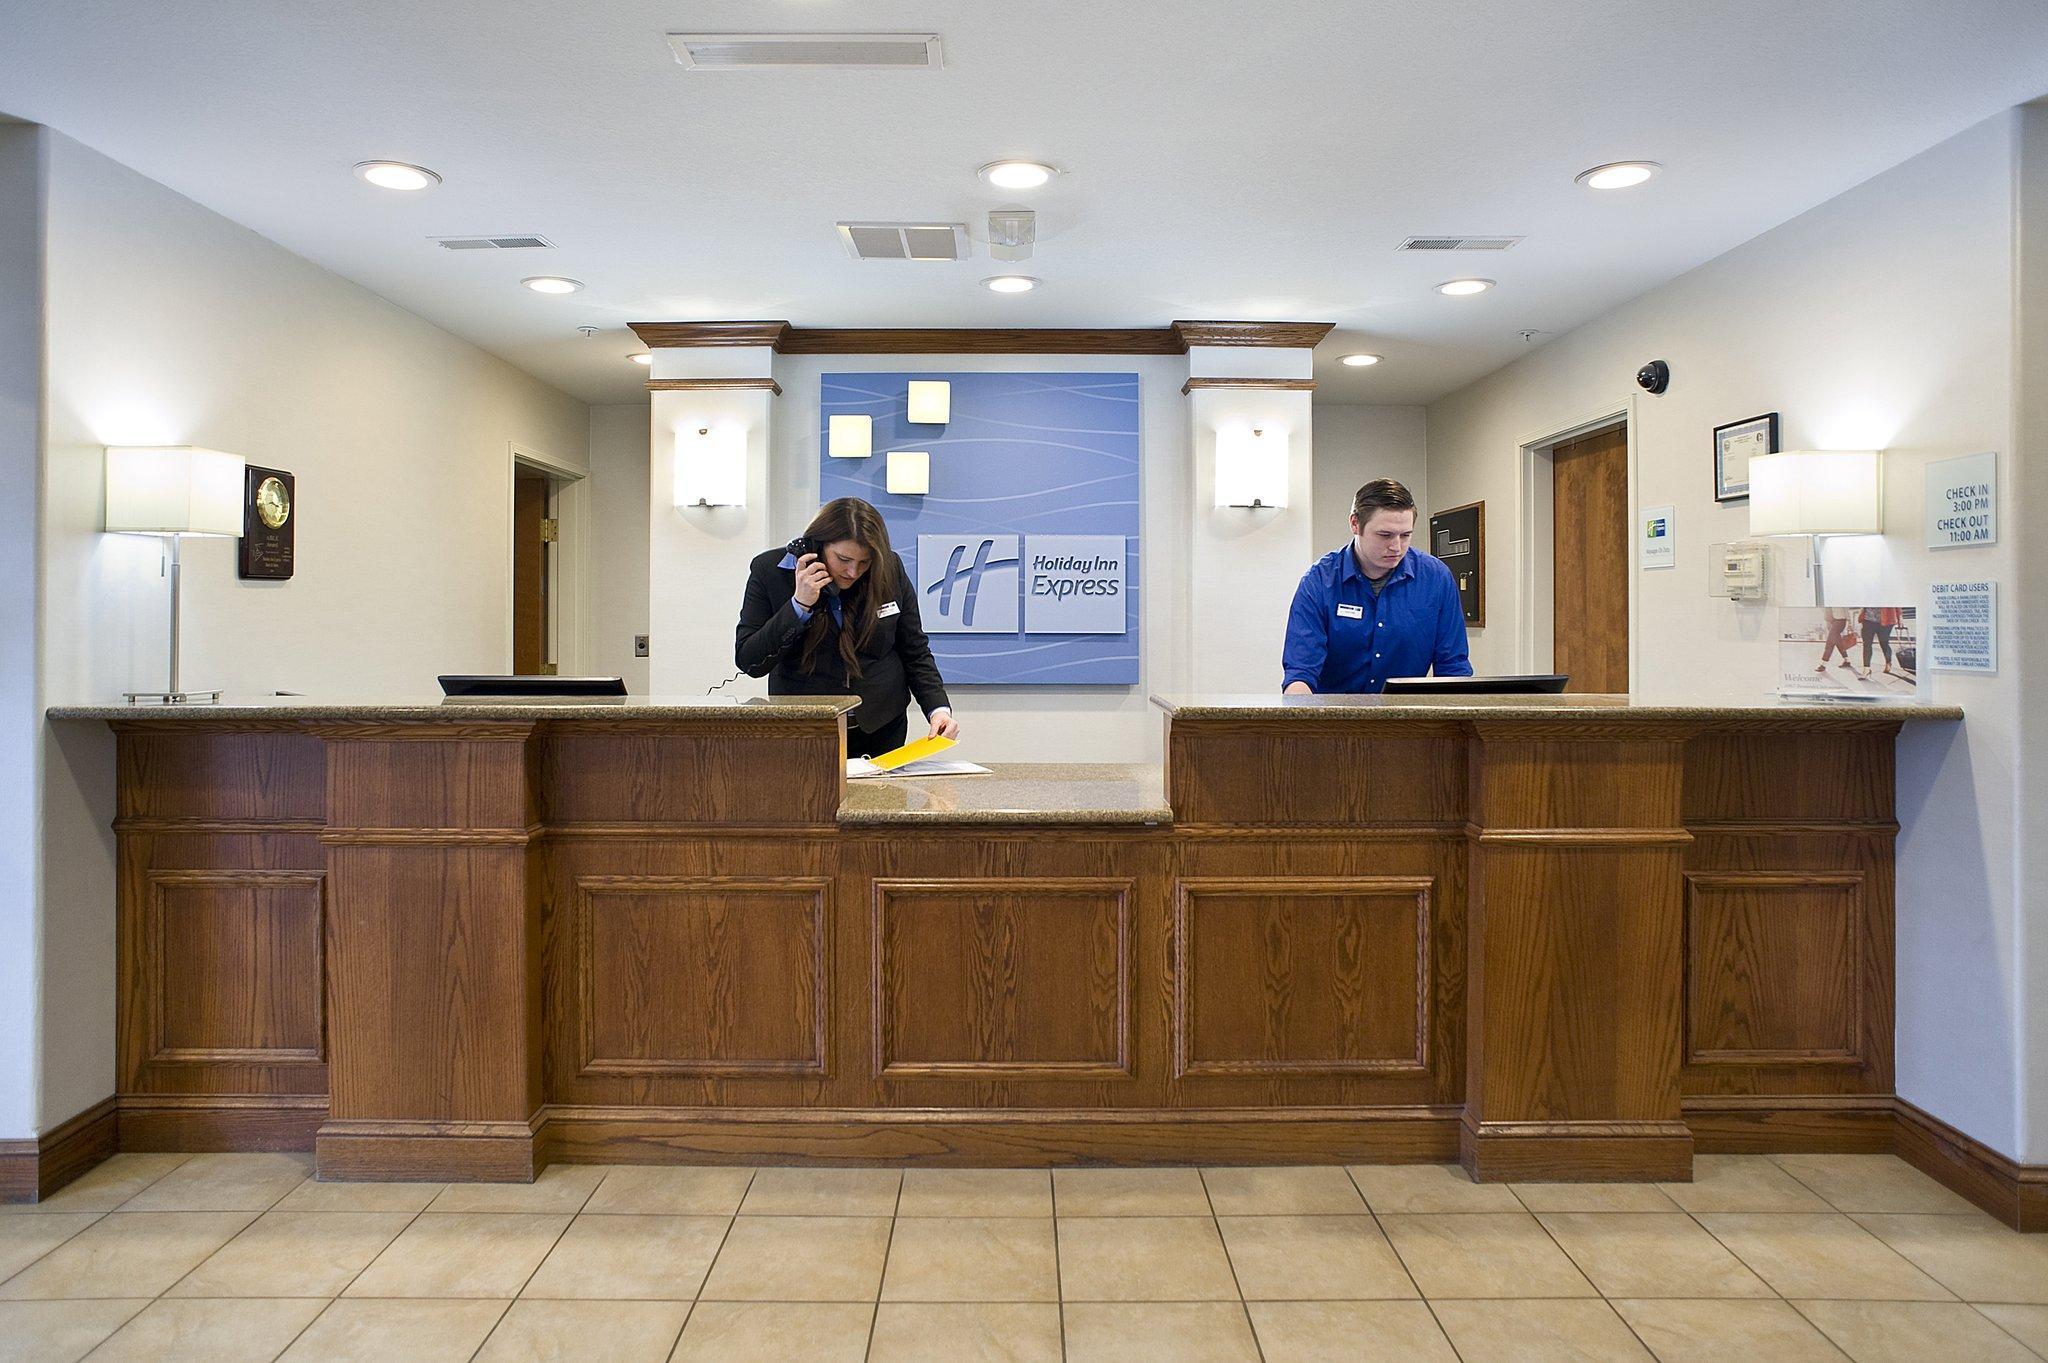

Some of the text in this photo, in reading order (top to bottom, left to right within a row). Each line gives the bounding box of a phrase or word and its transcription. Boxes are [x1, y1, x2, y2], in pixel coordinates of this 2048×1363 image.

[1946, 483, 1989, 500] CHECK IN
[1953, 498, 1989, 512] 3:00 PM
[1937, 515, 1989, 530] CHECK OUT
[1950, 528, 1989, 542] 11:00 AM
[1033, 555, 1118, 574] Holiday Inn
[1031, 575, 1119, 602] Express
[1932, 583, 1989, 593] DEBIT CARD USERS
[1784, 673, 1823, 682] Welcome
